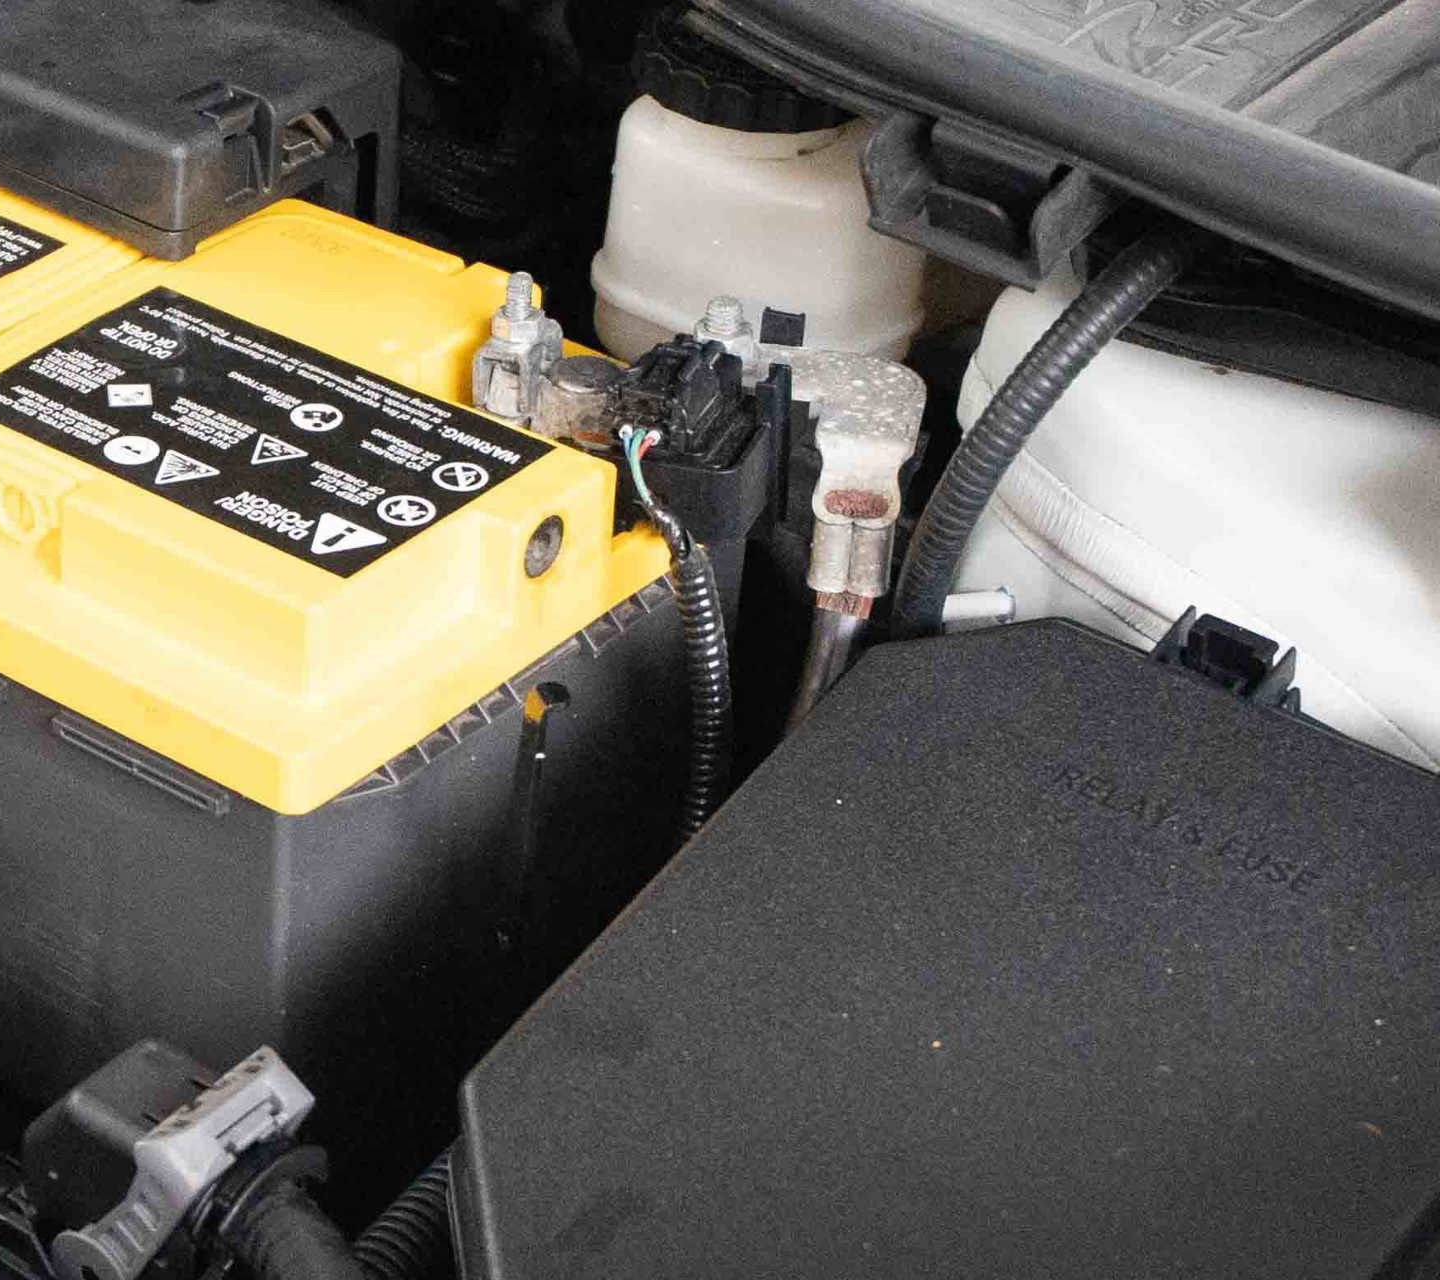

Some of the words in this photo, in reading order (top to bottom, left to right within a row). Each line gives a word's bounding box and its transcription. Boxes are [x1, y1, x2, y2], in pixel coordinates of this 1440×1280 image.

[99, 327, 123, 340] TIP
[117, 320, 157, 341] OPEN.
[118, 333, 152, 351] NOT
[153, 336, 178, 351] OR
[147, 346, 172, 359] DO
[91, 366, 119, 380] GET
[280, 362, 295, 372] Do
[227, 371, 302, 405] INSTRUCTIONS
[45, 400, 64, 410] OR
[170, 402, 189, 414] OR
[262, 394, 294, 409] READ
[51, 411, 75, 424] CAN
[176, 422, 230, 449] SULFURIC
[213, 430, 239, 444] CAN
[370, 428, 423, 454] SMOKING
[437, 425, 520, 464] WARNING:
[386, 444, 433, 466] FLAMES
[421, 450, 441, 461] OR
[405, 459, 425, 471] NO
[310, 460, 368, 488] CHILDREN
[310, 479, 337, 492] OUT
[318, 472, 360, 494] REACH
[365, 485, 385, 494] OF
[335, 490, 368, 506] KEEP
[356, 491, 377, 500] OF
[213, 496, 309, 540] DANGER/
[234, 491, 315, 530] POISON
